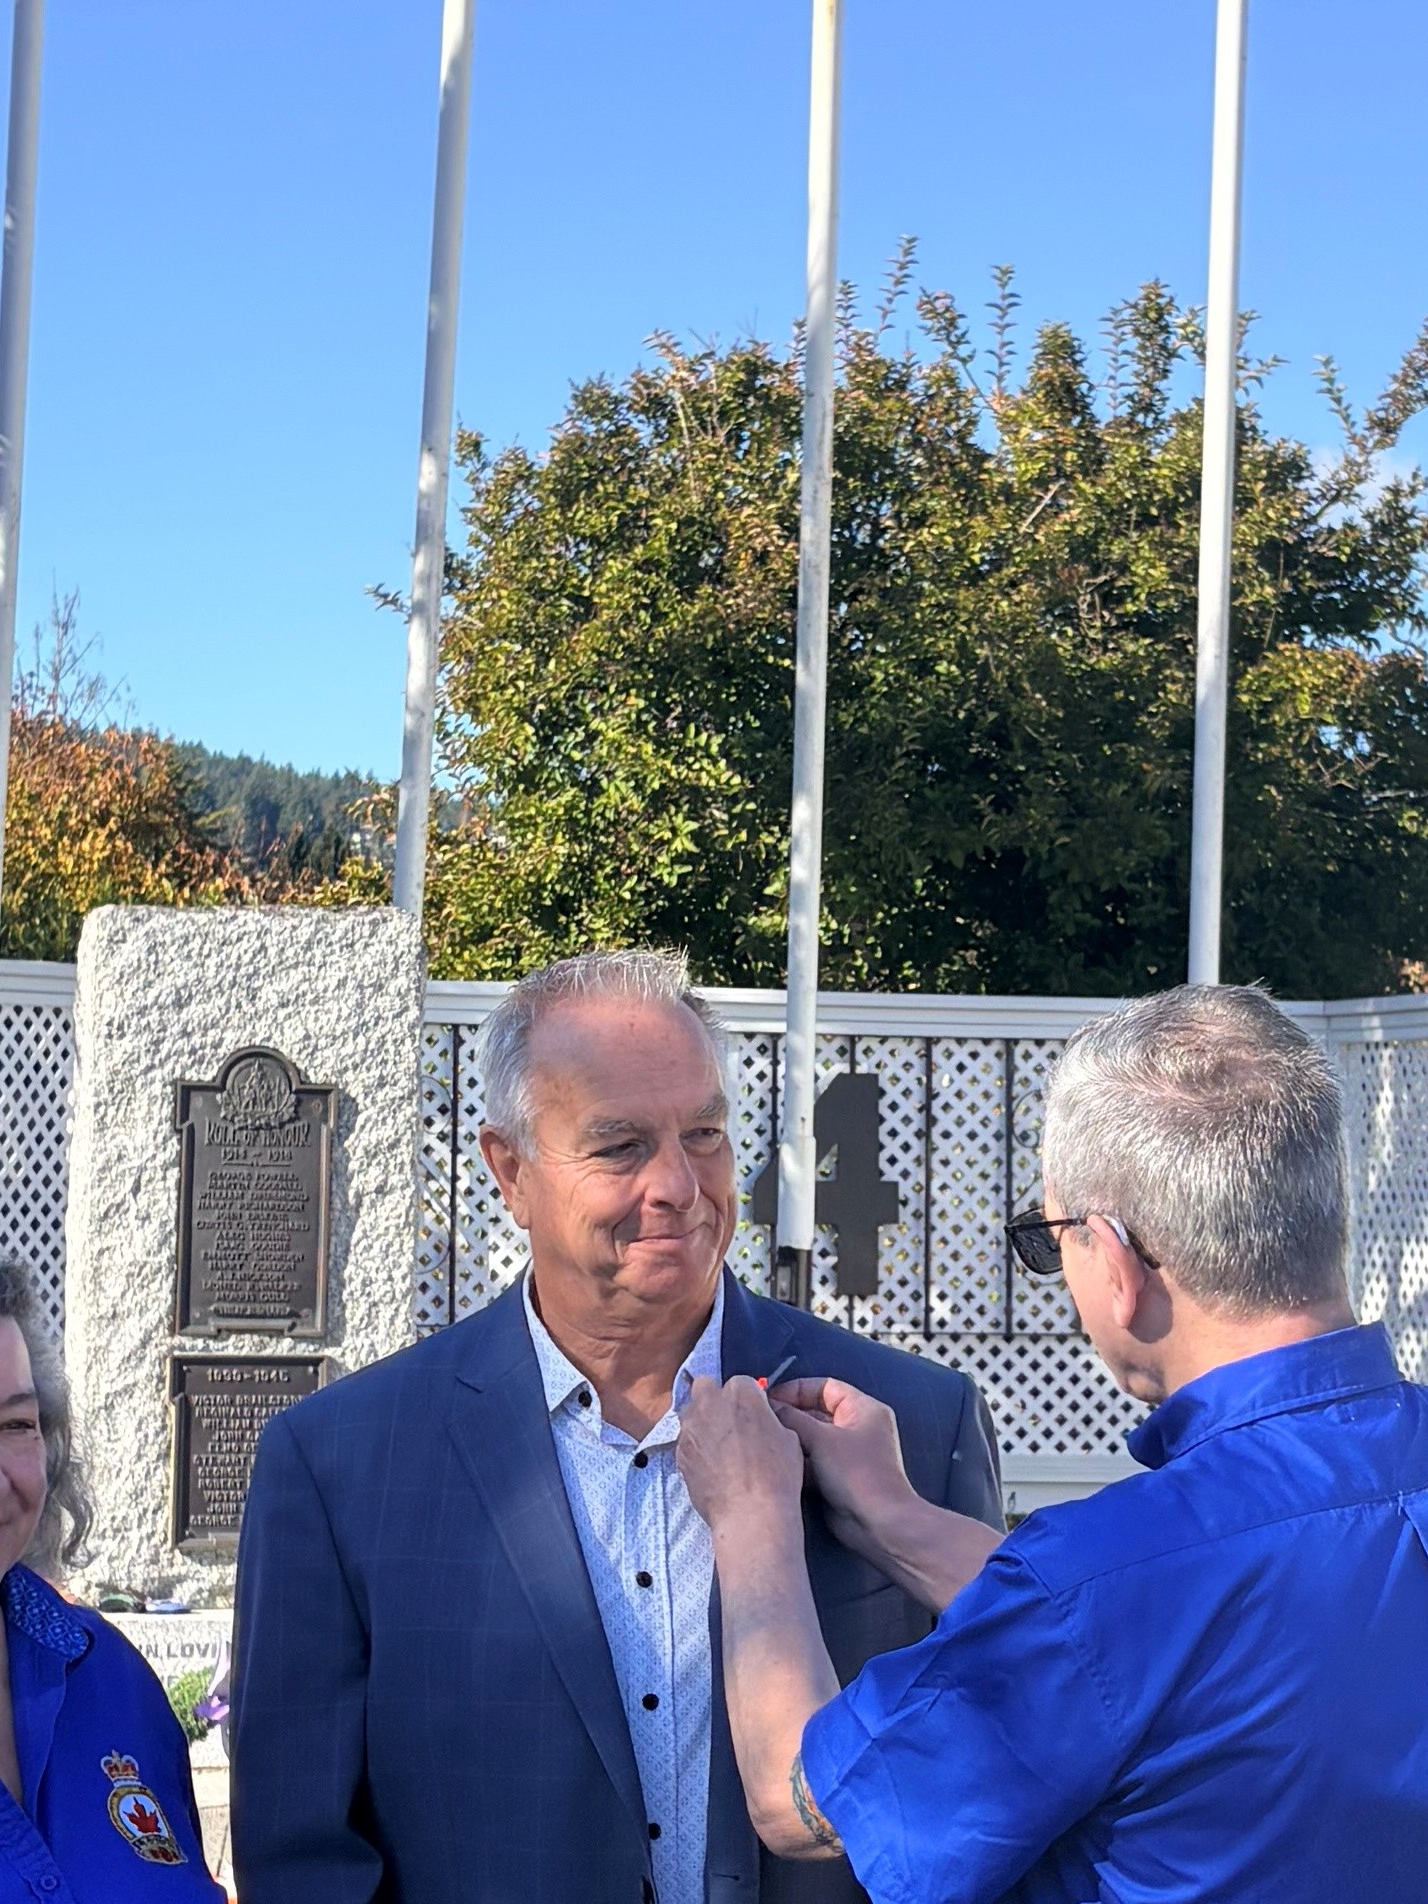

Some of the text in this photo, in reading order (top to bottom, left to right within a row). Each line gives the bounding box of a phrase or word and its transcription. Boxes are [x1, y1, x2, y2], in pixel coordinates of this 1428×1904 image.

[205, 1118, 311, 1147] ROLL OF HONOUR
[192, 1394, 233, 1407] VICTOR
[201, 1418, 251, 1430] WILLIAM
[197, 1466, 244, 1478] GEORGE
[197, 1478, 244, 1490] ROBERT
[202, 1490, 247, 1502] VICTOR
[206, 1502, 238, 1514] JOHN
